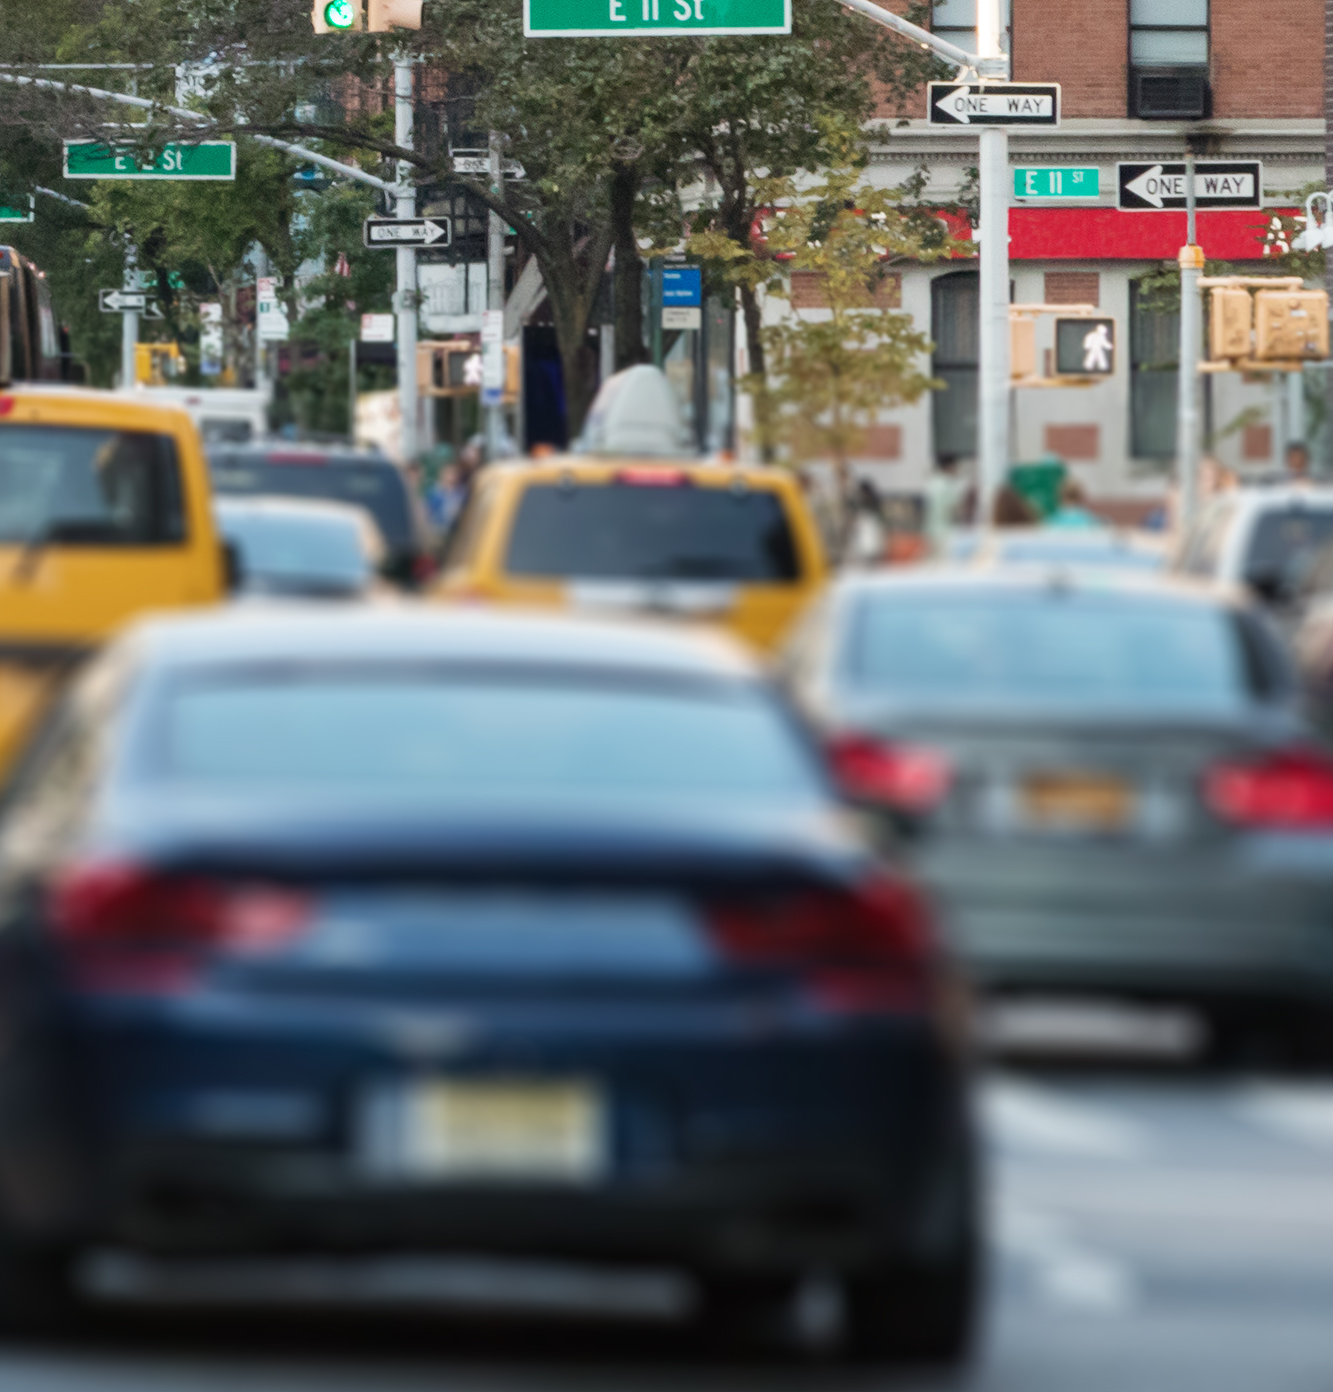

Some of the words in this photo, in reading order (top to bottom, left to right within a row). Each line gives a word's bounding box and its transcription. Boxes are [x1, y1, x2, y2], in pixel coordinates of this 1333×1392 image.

[954, 97, 988, 113] ONE
[1006, 98, 1044, 114] WAY
[162, 149, 184, 170] St
[1025, 170, 1038, 194] E
[1049, 170, 1063, 194] 11
[1072, 170, 1084, 184] ST
[1146, 177, 1185, 195] ONE
[1204, 177, 1245, 194] WAY
[377, 226, 402, 239] ONE
